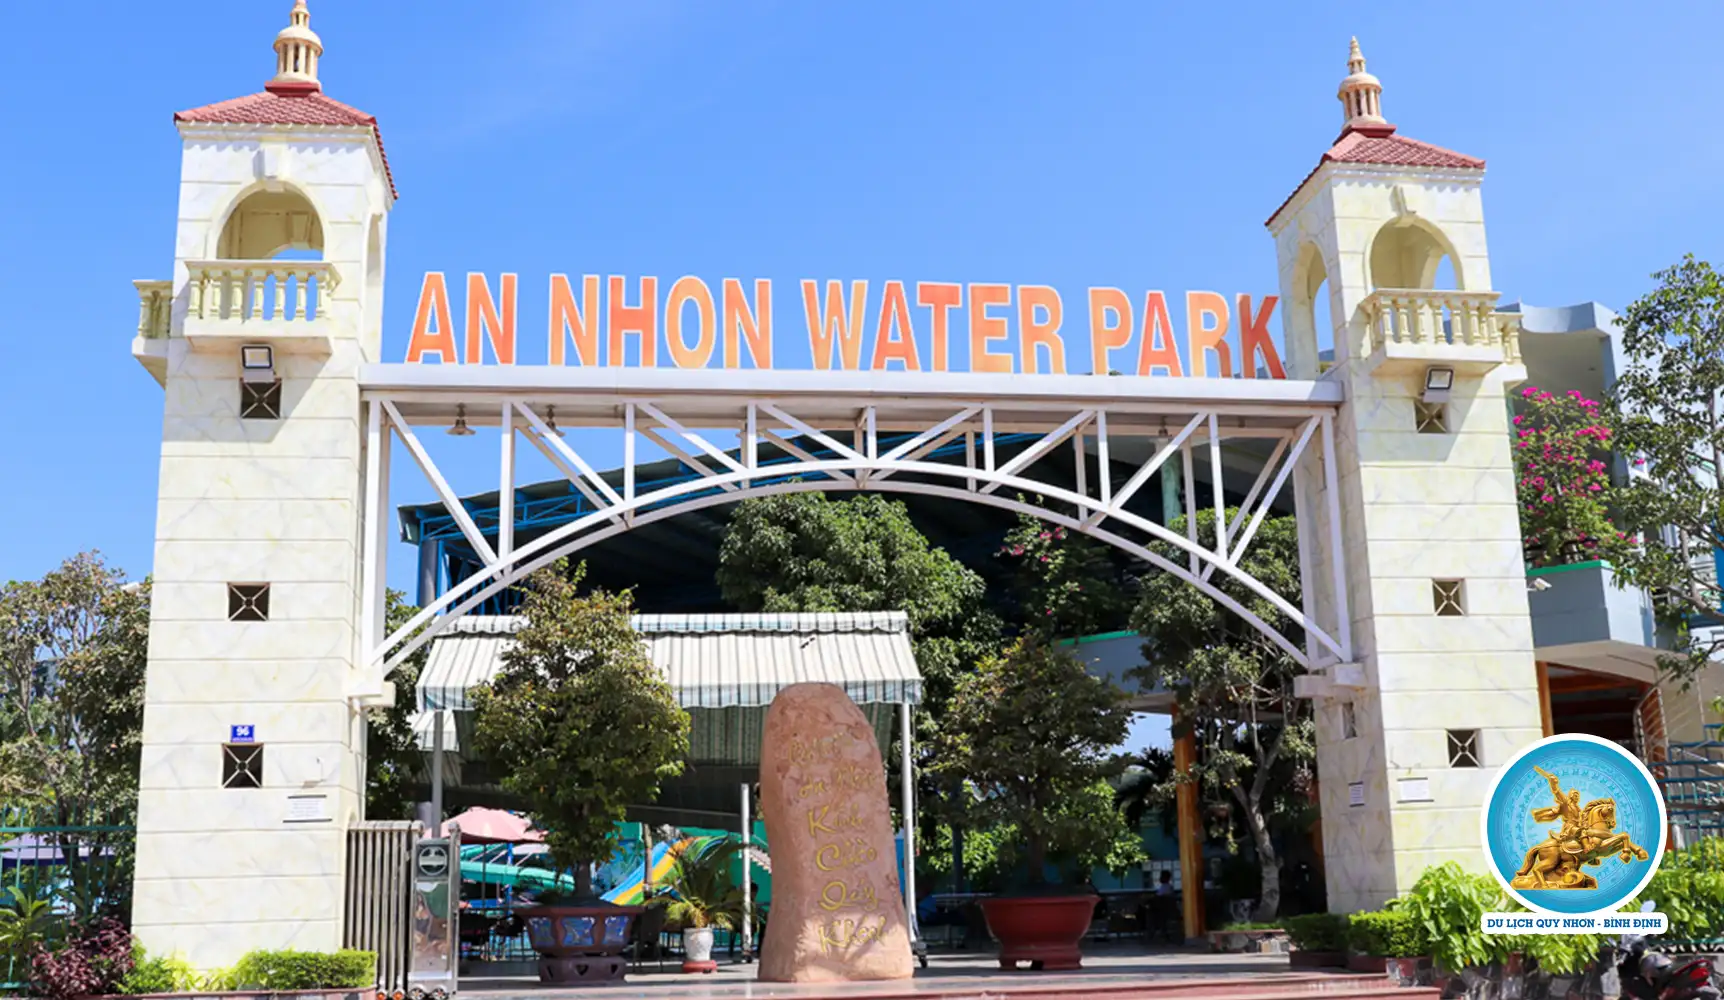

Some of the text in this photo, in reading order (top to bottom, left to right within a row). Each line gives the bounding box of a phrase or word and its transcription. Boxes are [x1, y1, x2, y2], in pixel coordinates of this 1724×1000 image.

[405, 272, 1287, 380] AN NHON WATER PARK
